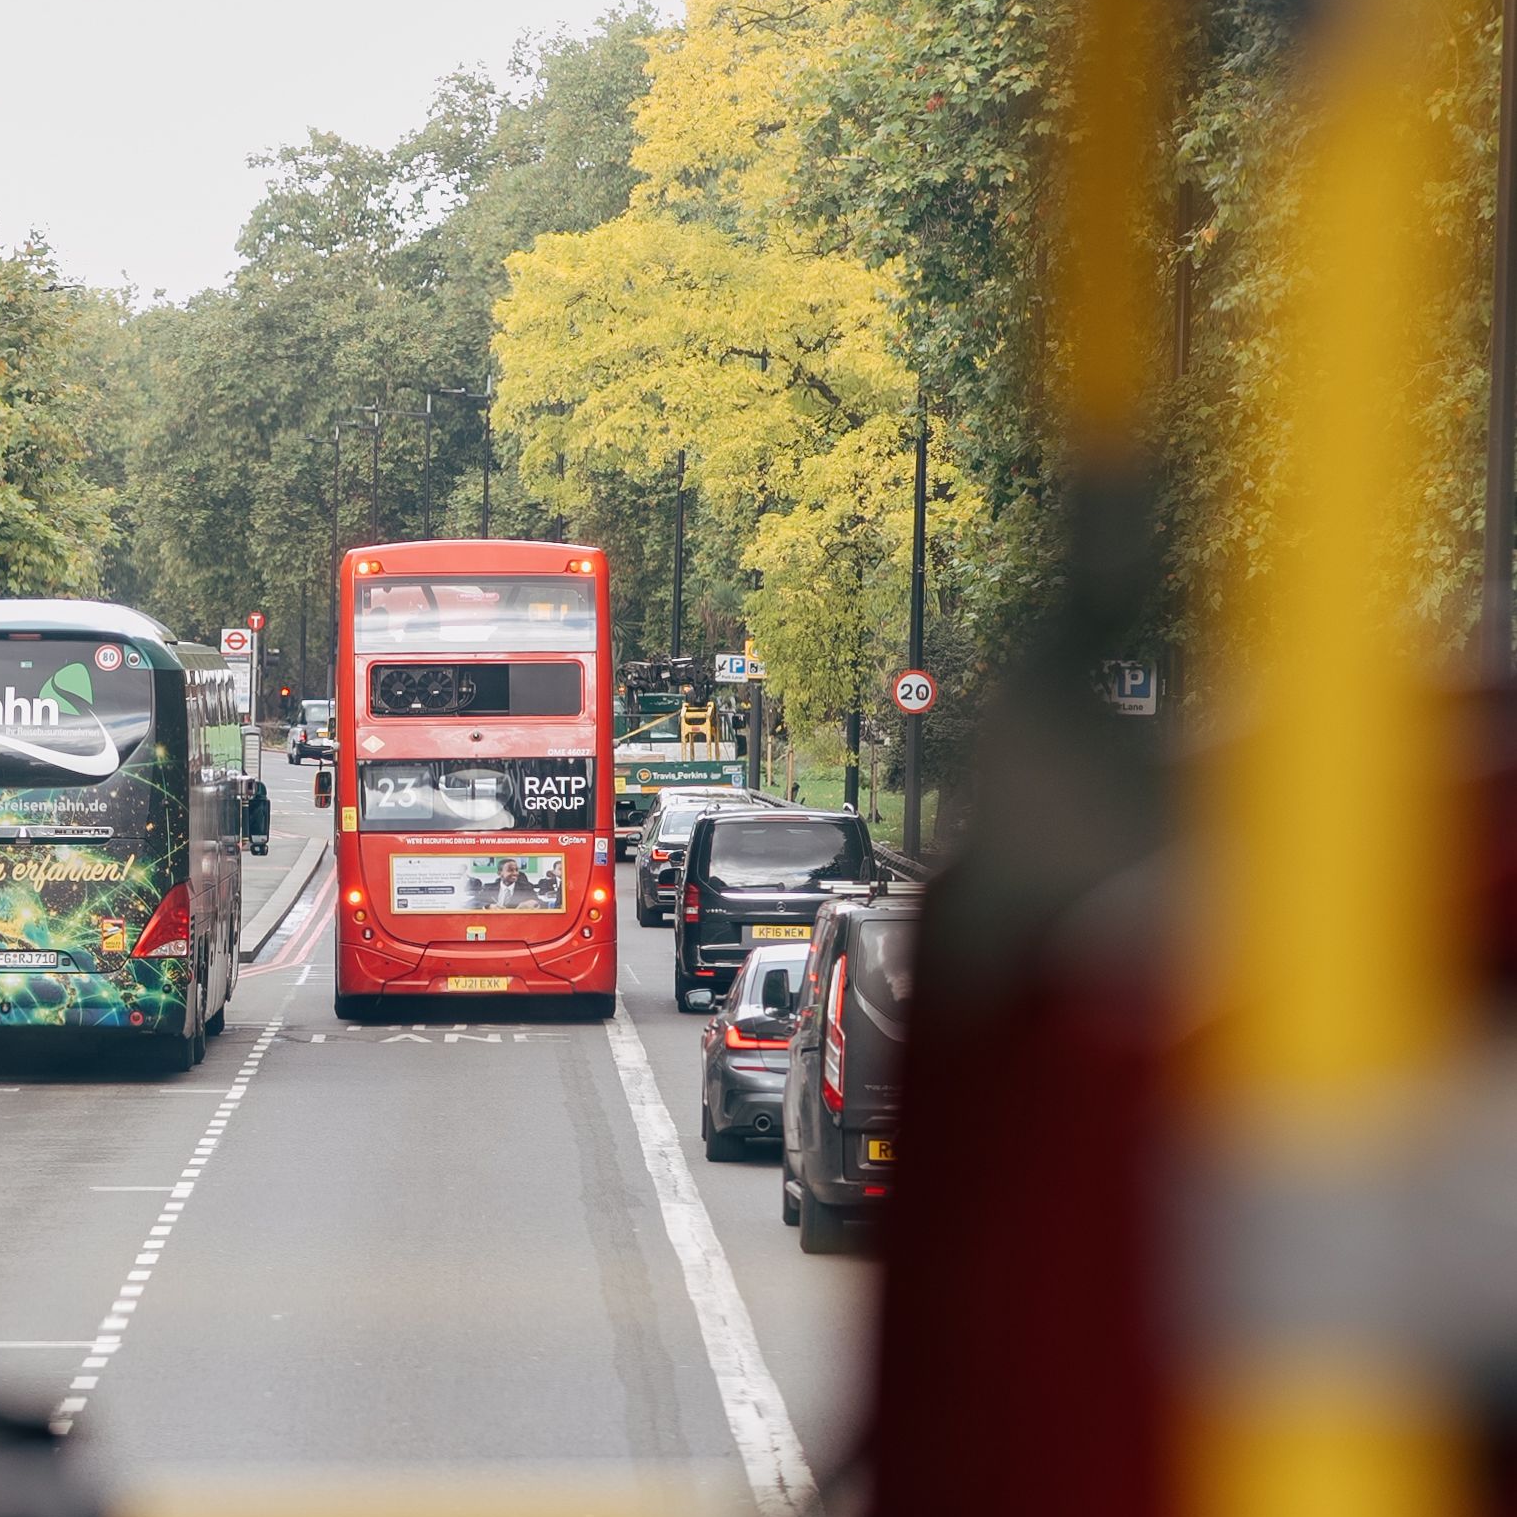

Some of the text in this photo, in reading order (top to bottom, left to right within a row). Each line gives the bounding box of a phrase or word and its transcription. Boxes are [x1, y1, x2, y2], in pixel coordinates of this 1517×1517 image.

[102, 652, 115, 662] 80
[900, 683, 930, 701] 20
[652, 771, 676, 780] Travis
[678, 770, 708, 780] Perkins
[377, 778, 418, 808] 23
[524, 776, 586, 795] RATP
[524, 795, 585, 812] GROUP
[12, 853, 135, 892] erfahren!
[758, 927, 782, 938] KF16
[19, 953, 33, 967] RJ
[35, 953, 56, 967] 710
[454, 978, 500, 989] YJ21 EXK
